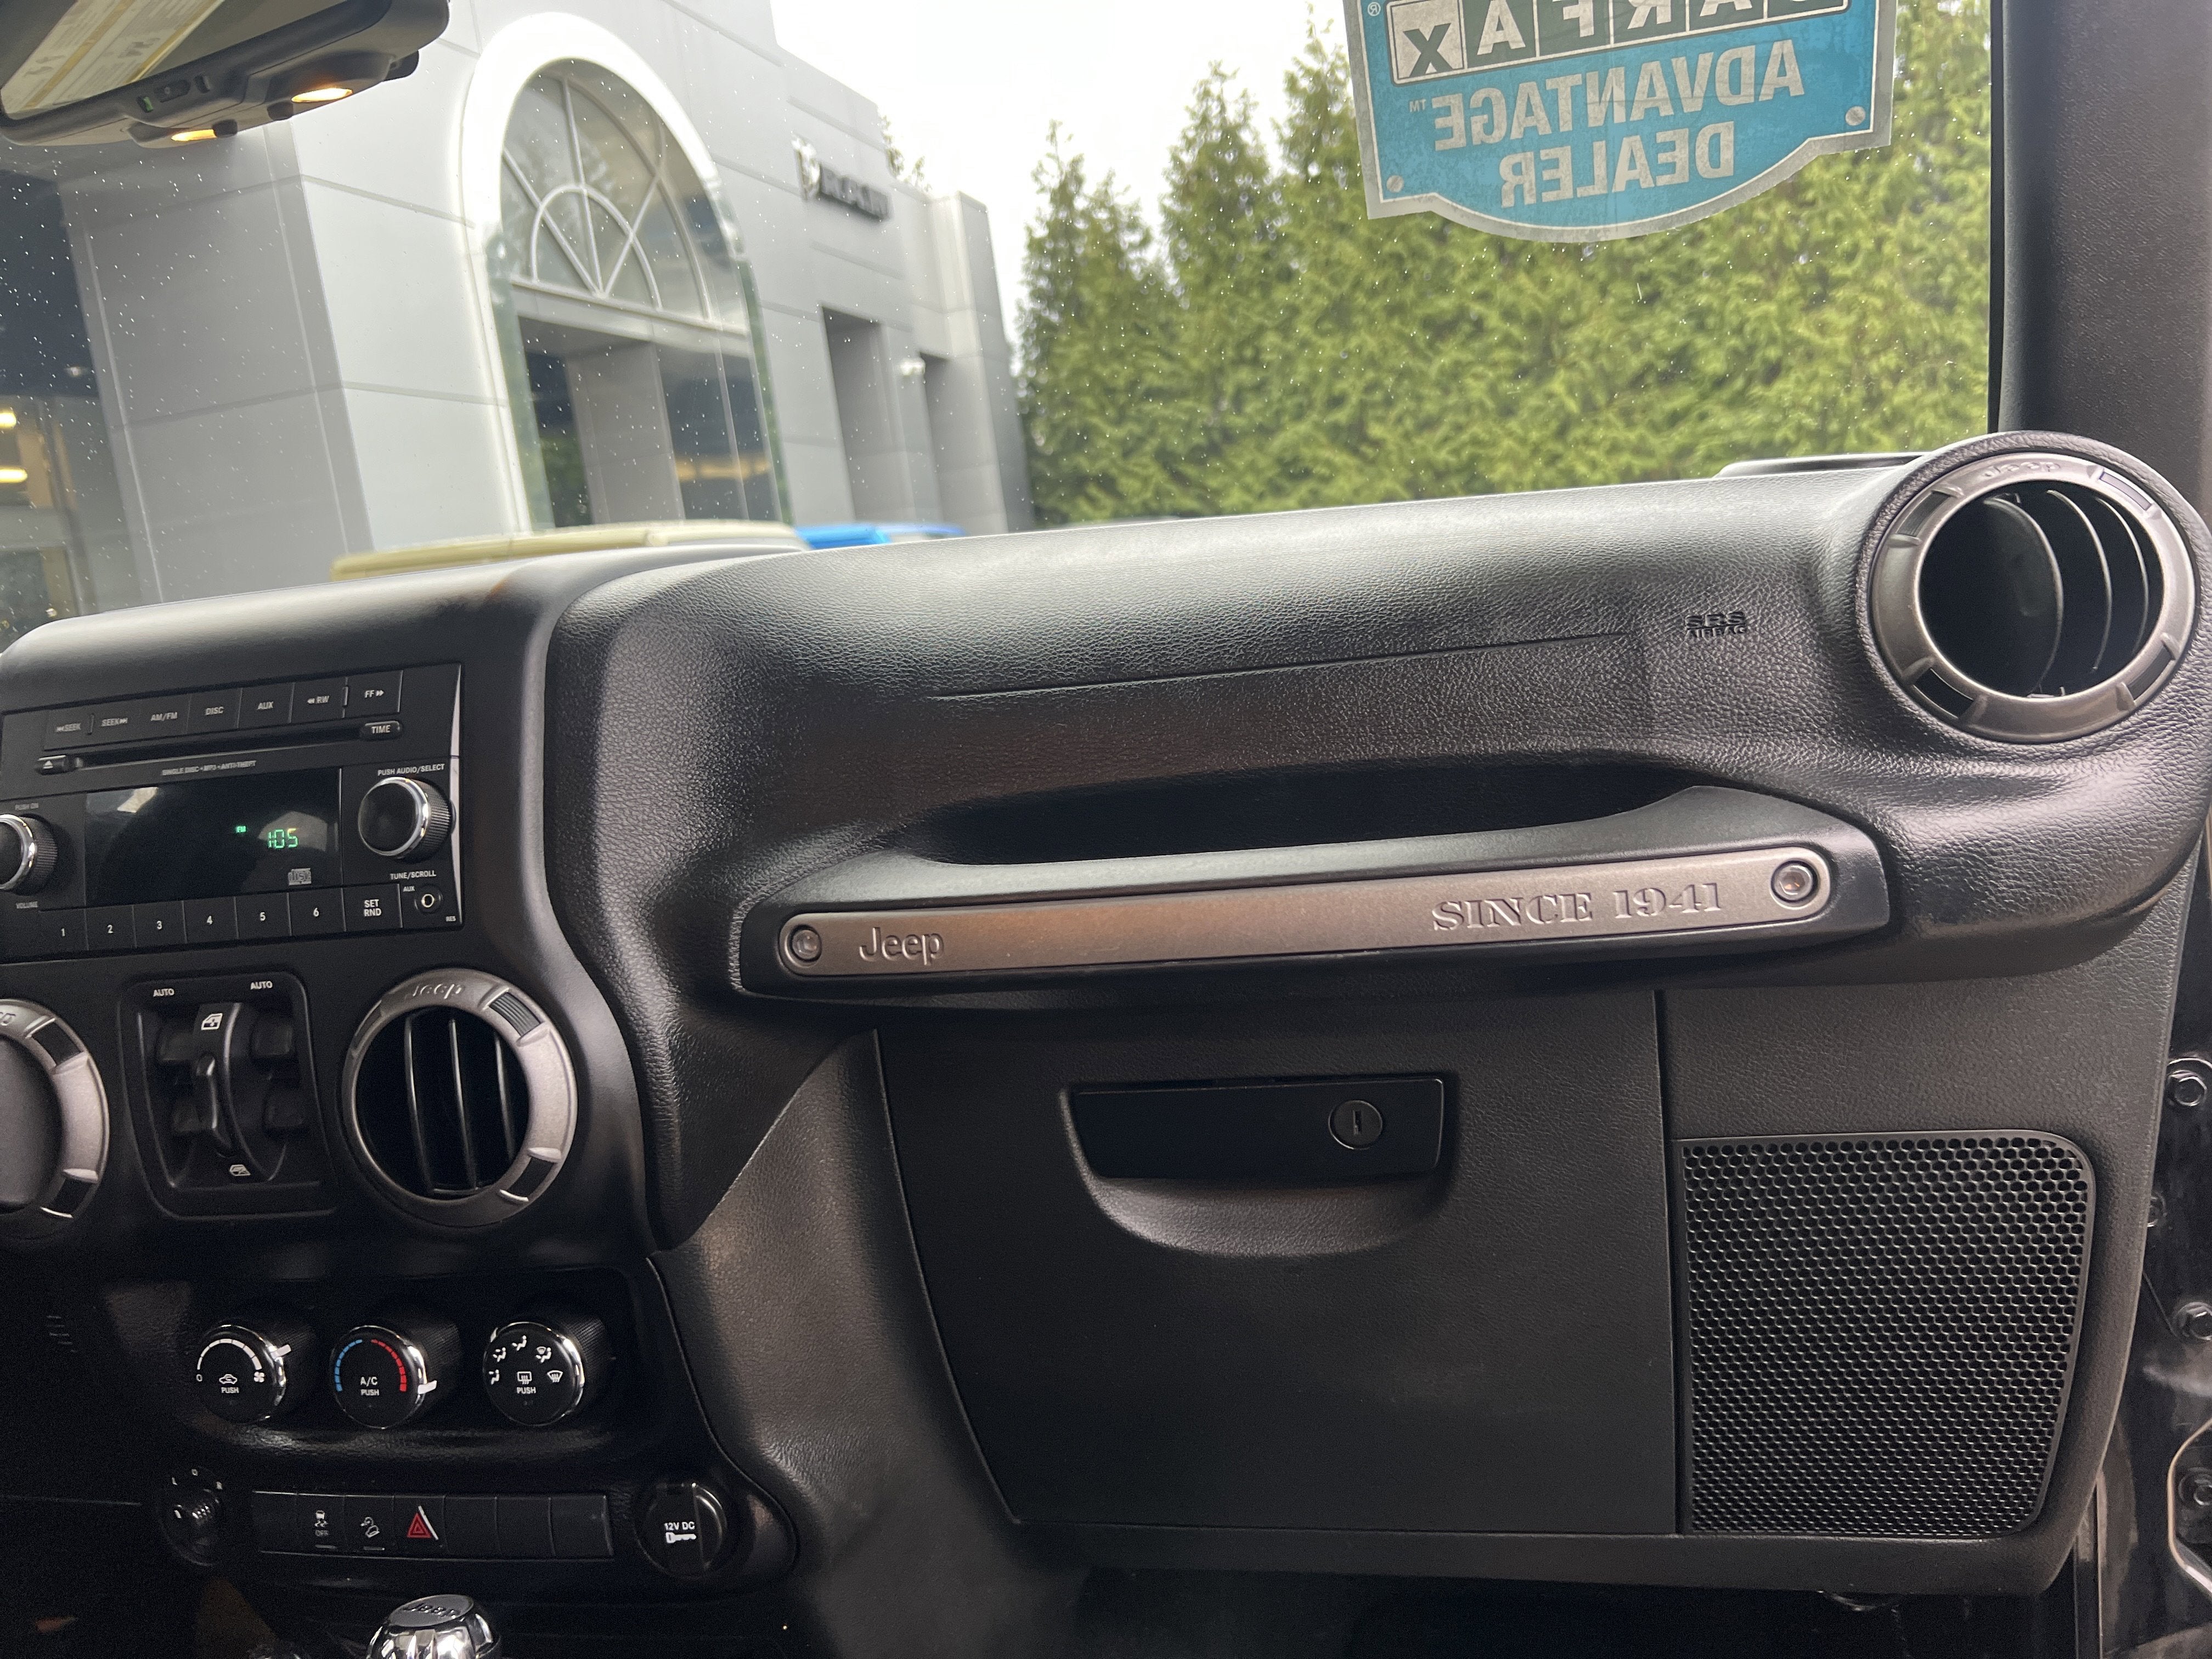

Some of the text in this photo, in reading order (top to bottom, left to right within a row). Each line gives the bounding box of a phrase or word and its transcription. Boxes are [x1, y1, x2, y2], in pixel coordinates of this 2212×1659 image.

[364, 690, 374, 698] FF
[316, 695, 329, 704] RW
[257, 701, 273, 710] AUX
[205, 706, 224, 715] DISC
[150, 712, 178, 721] AM/FM
[101, 718, 119, 727] SEEK
[371, 725, 391, 733] TIME
[377, 763, 445, 776] PUSH AUDIO/SELECT
[390, 870, 437, 880] TUNE/SCROLL
[364, 899, 379, 908] SET
[1431, 883, 1722, 930] SINCE 1941
[259, 912, 266, 921] 5
[313, 908, 319, 917] 6
[364, 908, 382, 917] RND
[156, 920, 162, 929] 3
[206, 916, 213, 925] 4
[61, 928, 65, 936] 1
[107, 924, 113, 934] 2
[859, 927, 944, 966] Jeep
[250, 980, 273, 990] AUTO
[153, 989, 174, 997] AUTO
[360, 1377, 378, 1386] A/C
[664, 1521, 695, 1530] 12V DC
